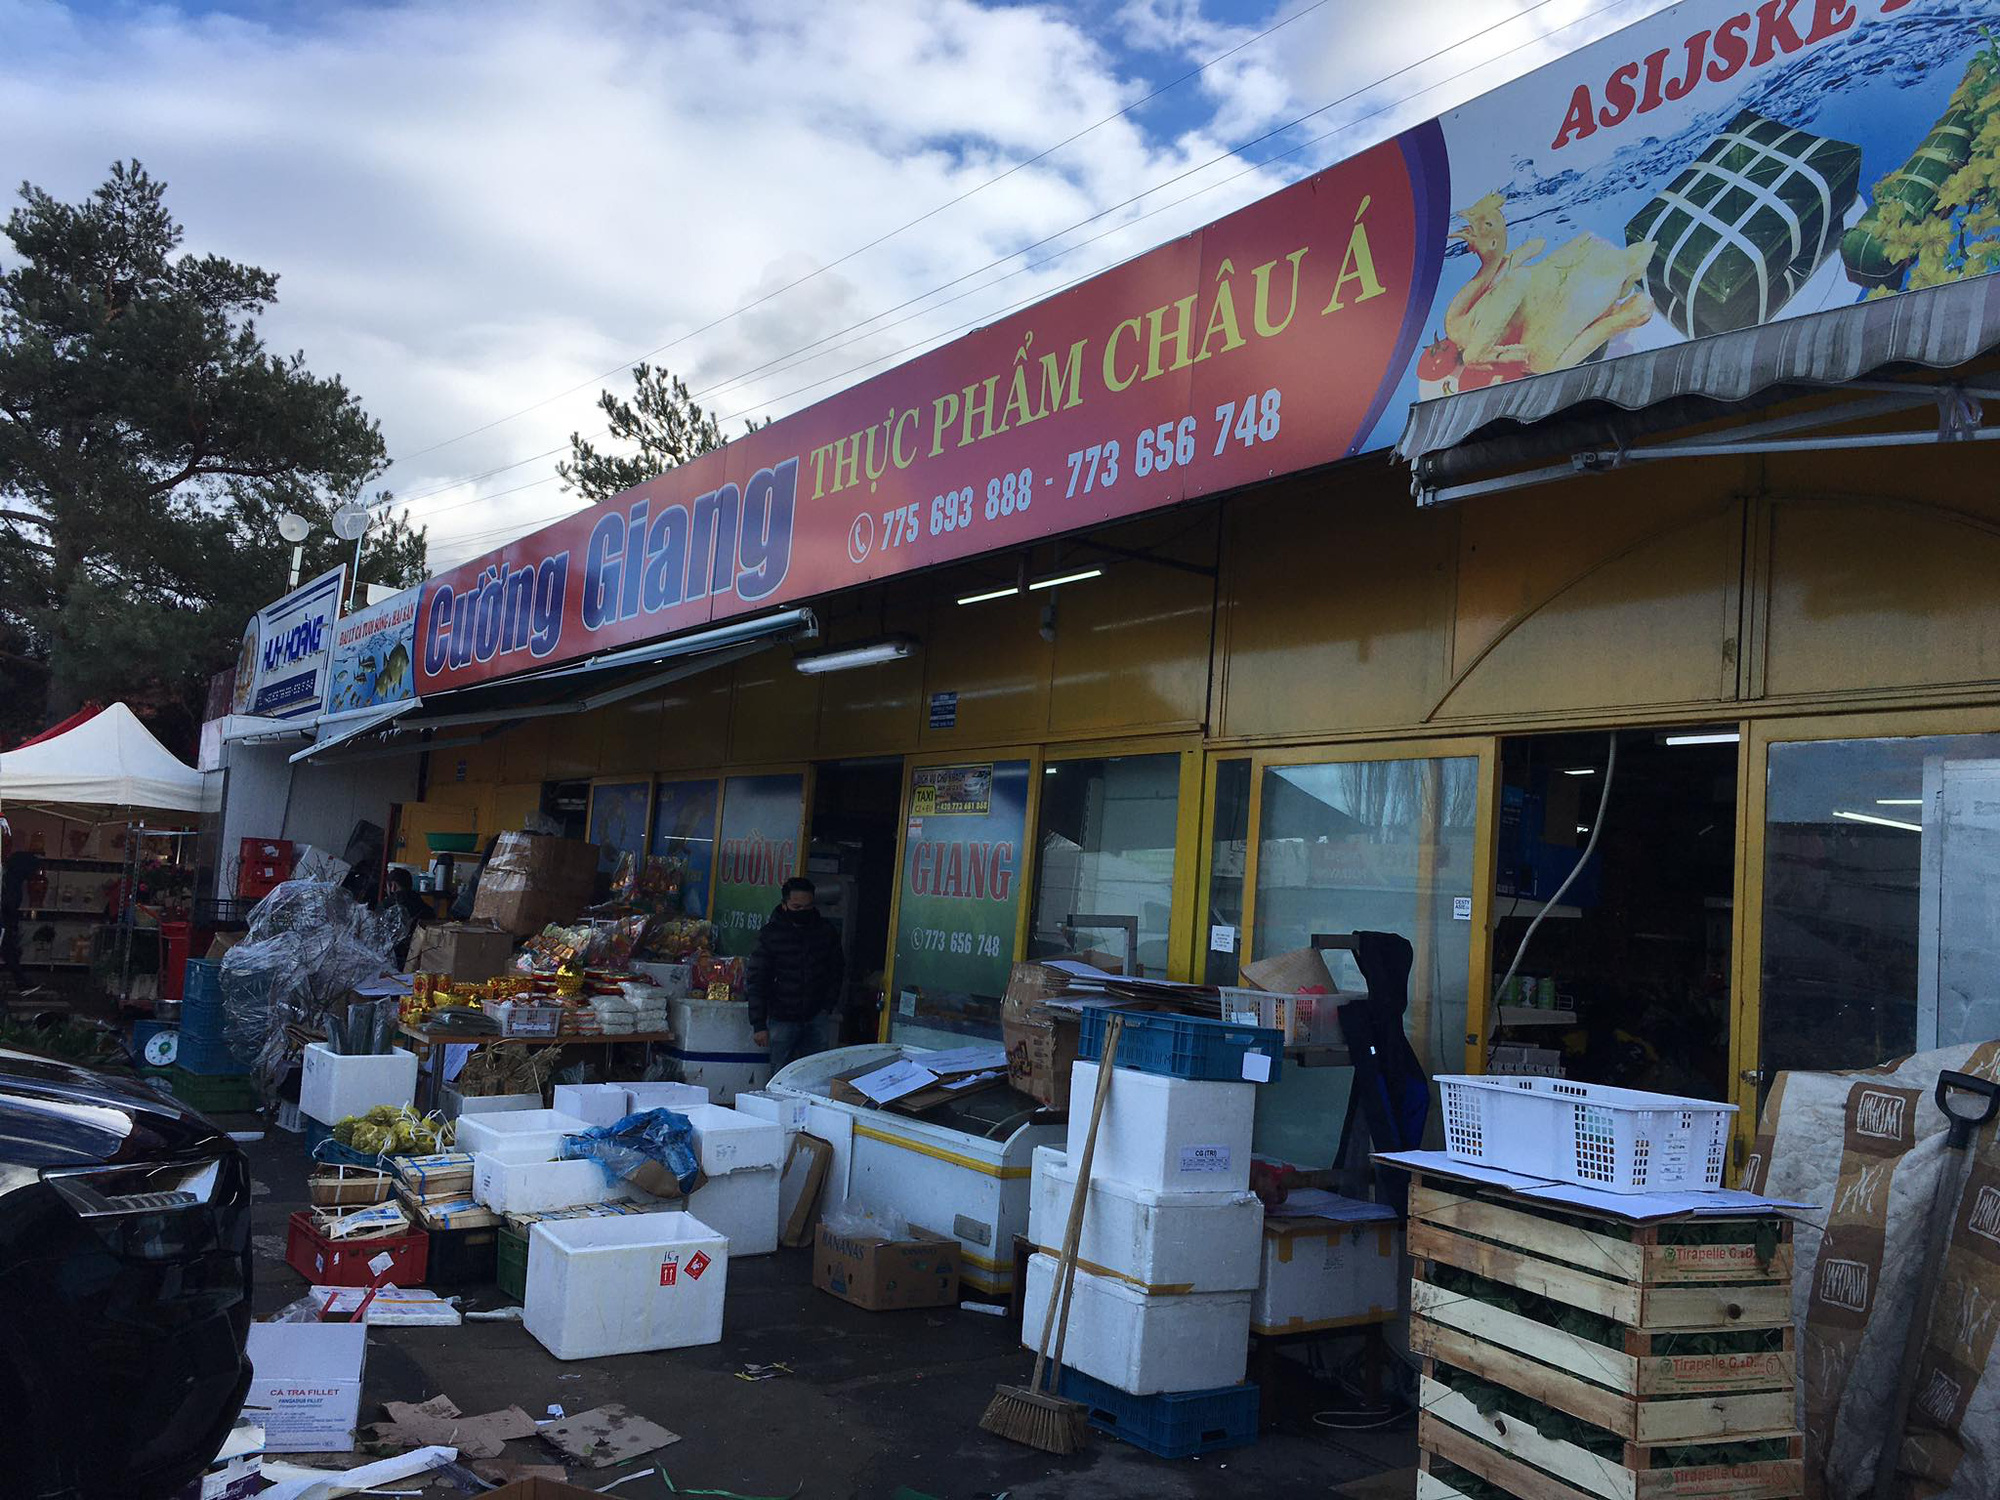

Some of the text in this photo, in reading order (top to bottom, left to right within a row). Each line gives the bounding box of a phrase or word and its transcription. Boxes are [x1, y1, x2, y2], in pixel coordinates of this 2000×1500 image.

[810, 195, 1387, 500] THỰC PHẨM CHÂU Á
[880, 502, 919, 552] 775
[929, 485, 974, 538] 693
[984, 467, 1033, 522] 888
[1065, 439, 1120, 499] 773
[1134, 415, 1197, 479] 656
[1213, 387, 1282, 457] 748
[424, 455, 799, 677] Cường Giang
[262, 635, 285, 672] HUY
[917, 789, 934, 802] TAXI
[911, 840, 1012, 901] GIANG
[731, 910, 745, 929] 775
[925, 929, 1000, 957] 773 656 748
[1676, 1247, 1725, 1262] Tirapelle
[1673, 1357, 1726, 1373] Tirapelle
[307, 1388, 340, 1396] FILLET
